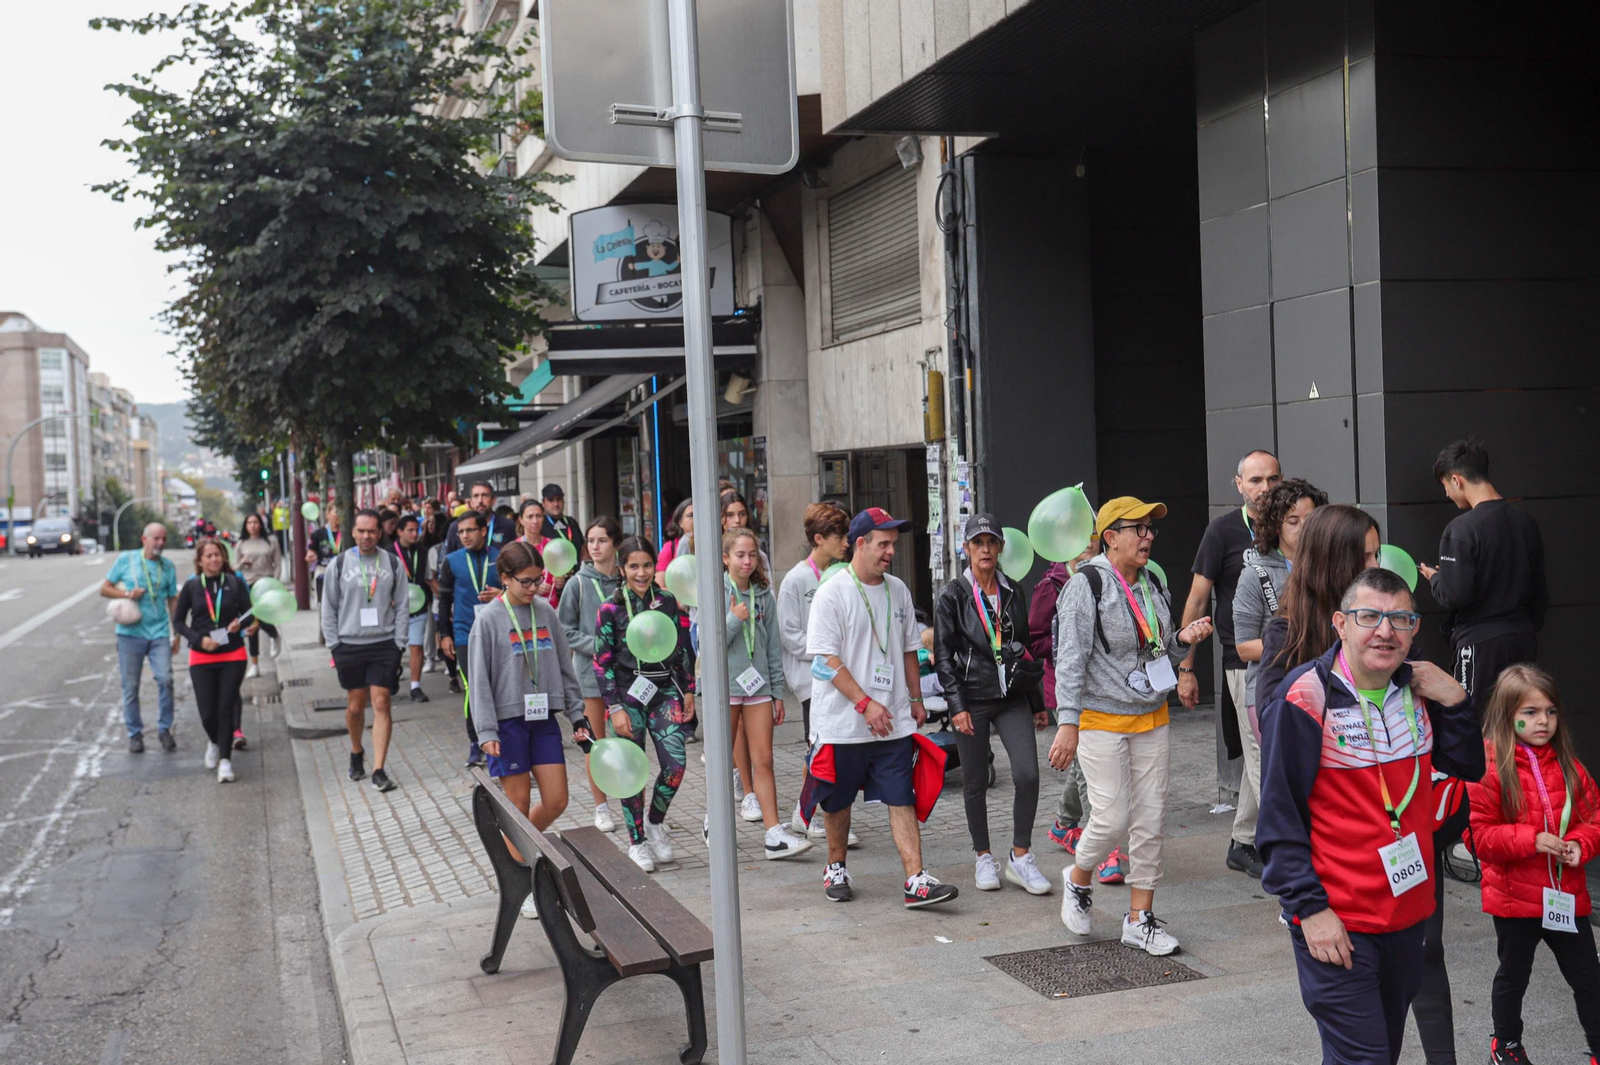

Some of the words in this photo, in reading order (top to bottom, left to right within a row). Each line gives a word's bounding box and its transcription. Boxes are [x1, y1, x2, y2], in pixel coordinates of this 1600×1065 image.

[596, 244, 605, 253] La
[609, 283, 651, 296] CAFETERÍA
[1262, 580, 1279, 612] BIMBA
[1460, 645, 1472, 692] Champ
[746, 676, 761, 691] 0491
[874, 675, 891, 685] 1679
[639, 683, 654, 701] 0970
[526, 707, 547, 716] 0467
[1392, 860, 1422, 884] 0805
[1548, 911, 1570, 925] 0811
